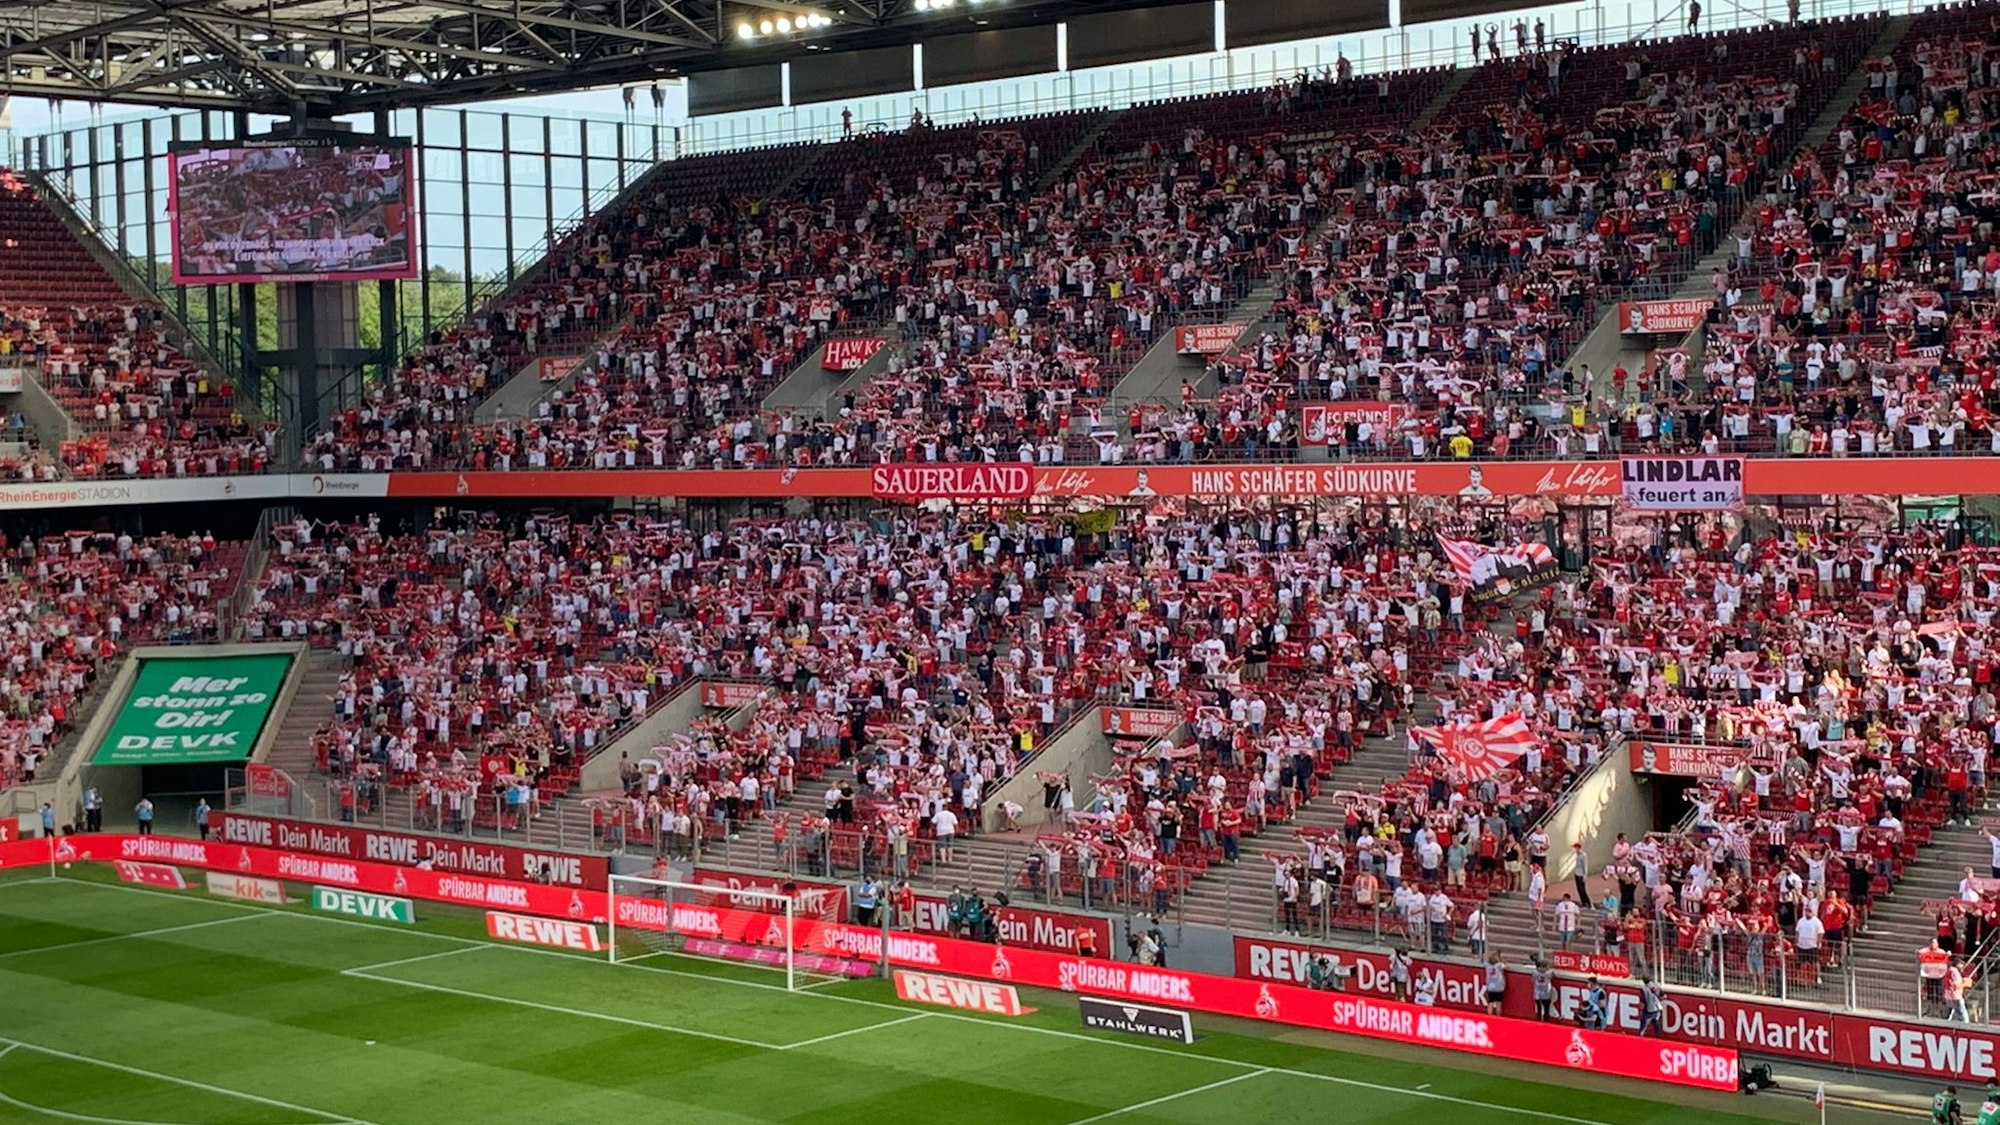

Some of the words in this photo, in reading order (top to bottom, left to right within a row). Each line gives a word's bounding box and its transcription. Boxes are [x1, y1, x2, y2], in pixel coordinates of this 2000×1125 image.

[1647, 304, 1671, 315] HANS
[1647, 315, 1695, 329] SÜDKURVE
[825, 339, 887, 363] HAWKS
[1327, 411, 1342, 423] FC
[873, 467, 1029, 494] SAUERLAND
[1191, 471, 1235, 493] HANS
[1240, 466, 1317, 493] SCHÄFER
[1323, 465, 1417, 493] SÜDKURVE
[1622, 459, 1742, 482] LINDLAR
[1639, 487, 1696, 503] feuert
[1703, 490, 1726, 503] an
[169, 676, 248, 694] Mer
[133, 694, 227, 708] stonn
[229, 692, 267, 706] zo
[155, 709, 234, 729] Dir!
[116, 731, 241, 750] DEVK
[1669, 748, 1695, 760] HANS
[1669, 760, 1719, 775] SÜDKURVE
[122, 837, 171, 858] SPÜRBAR
[171, 842, 208, 863] ANDERS.
[224, 817, 273, 846] REWE
[279, 824, 308, 849] Dein
[310, 828, 351, 855] Markt
[366, 833, 418, 863] REWE
[427, 841, 458, 869] Dein
[461, 845, 506, 876] Markt
[279, 854, 320, 878] SPÜRBAR
[235, 879, 265, 899] kik
[439, 875, 485, 899] SPÜRBAR
[486, 883, 529, 907] ANDERS.
[320, 890, 399, 920] DEVK
[619, 900, 668, 925] SPÜRBAR
[672, 908, 722, 934] ANDERS.
[498, 918, 587, 949] REWE
[998, 913, 1028, 941] ein
[1033, 916, 1097, 949] Mar
[823, 927, 882, 955] SPÜRBAR
[887, 936, 940, 964] ANDERS.
[1554, 955, 1575, 967] RED
[1591, 960, 1629, 974] GOATS
[1058, 960, 1126, 990] SPÜRBAR
[1130, 970, 1195, 1001] ANDERS.
[1421, 967, 1489, 1007] Mark
[903, 975, 1007, 1013] REWE
[1086, 1014, 1180, 1038] STAHLWERK
[1333, 999, 1413, 1035] SPÜRBAR
[1417, 1014, 1494, 1048] ANDERS.
[1662, 999, 1726, 1040] Dein
[1736, 1009, 1830, 1055] Markt
[1869, 1025, 1996, 1078] REWE
[1659, 1049, 1738, 1083] SPÜRBA
